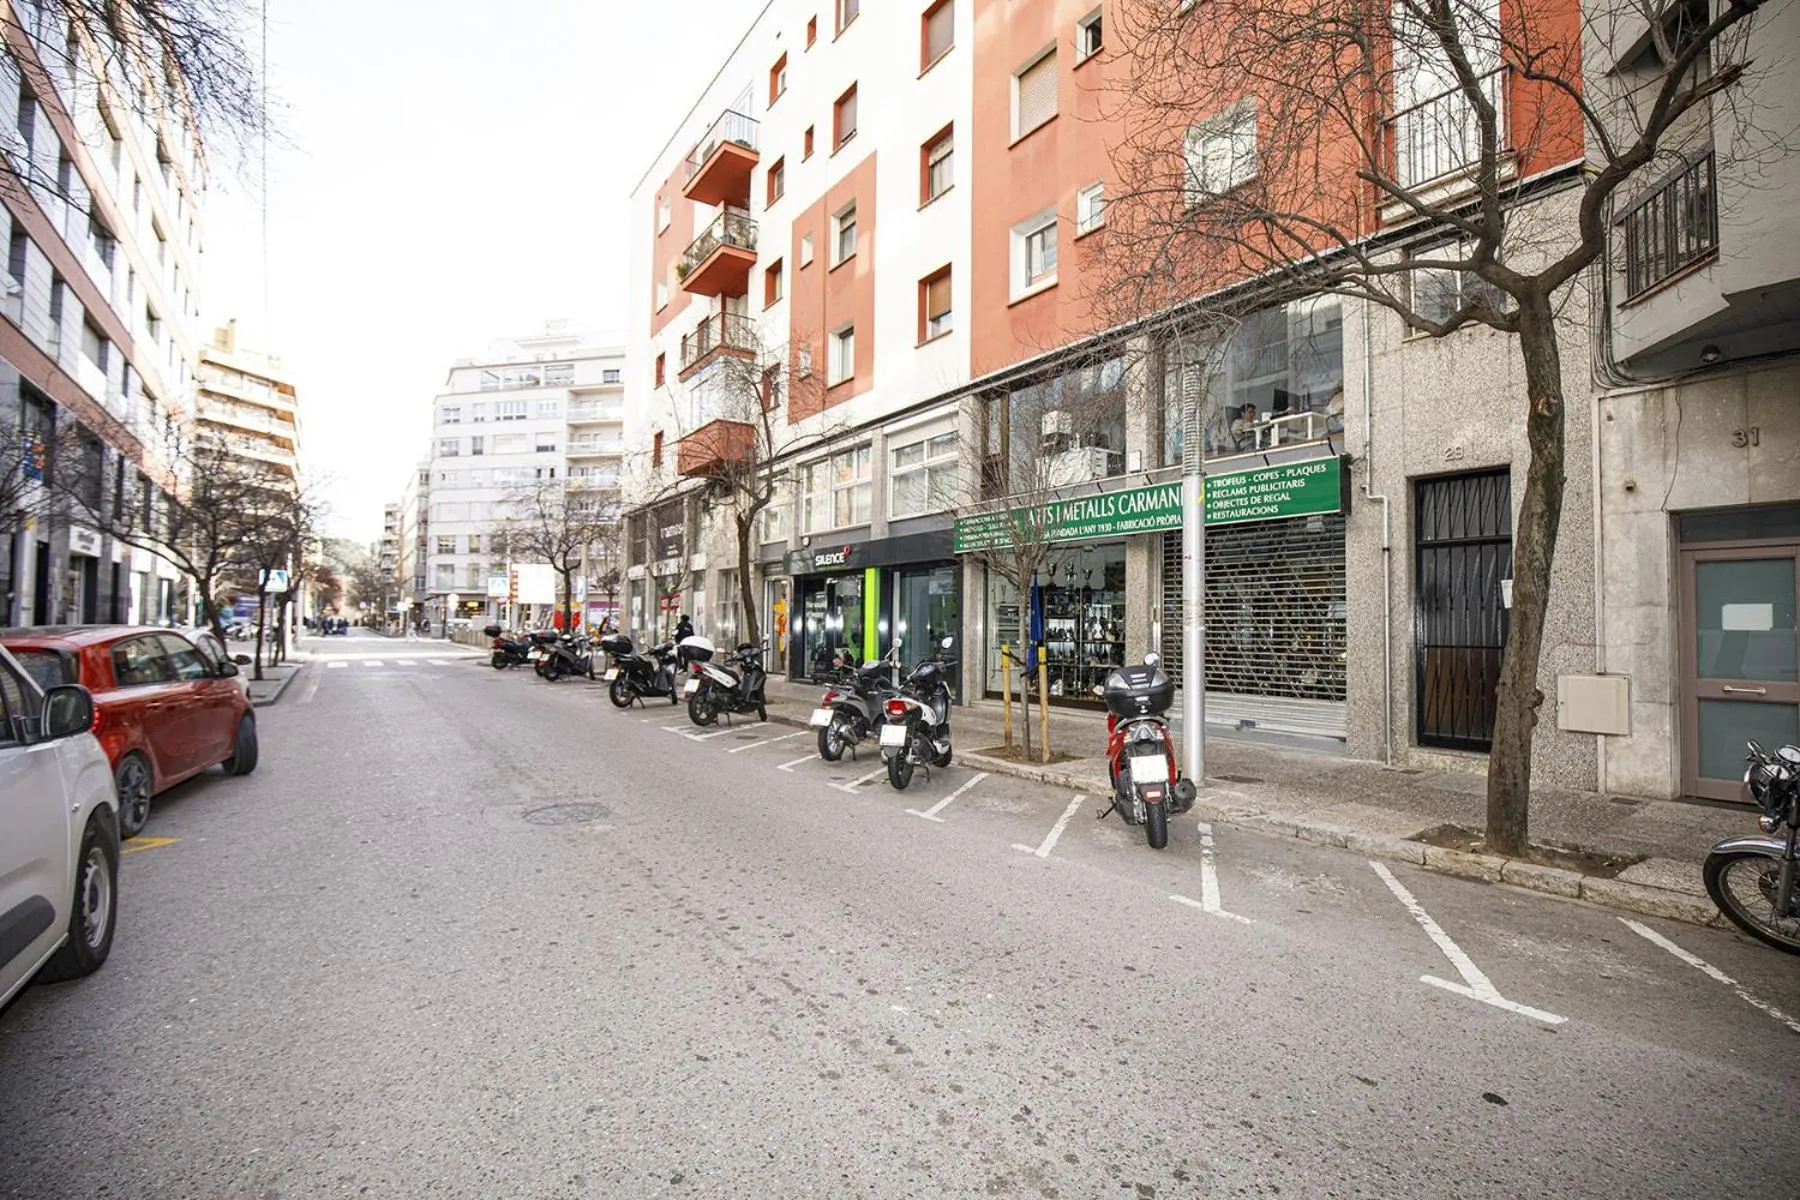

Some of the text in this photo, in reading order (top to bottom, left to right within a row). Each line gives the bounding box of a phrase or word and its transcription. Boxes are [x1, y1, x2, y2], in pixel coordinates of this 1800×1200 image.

[1731, 426, 1760, 448] 31
[1212, 476, 1246, 488] TROFEUS
[1253, 471, 1280, 482] COPES
[1286, 463, 1327, 477] PLAQUES
[1212, 479, 1305, 499] RECLAMS PUBLICITARIS
[1062, 496, 1114, 521] METALLS
[1212, 492, 1291, 510] OBJECTES DE REGAL
[1212, 505, 1279, 520] RESTAURACIONS
[1116, 515, 1155, 531] FABRICACIÓ
